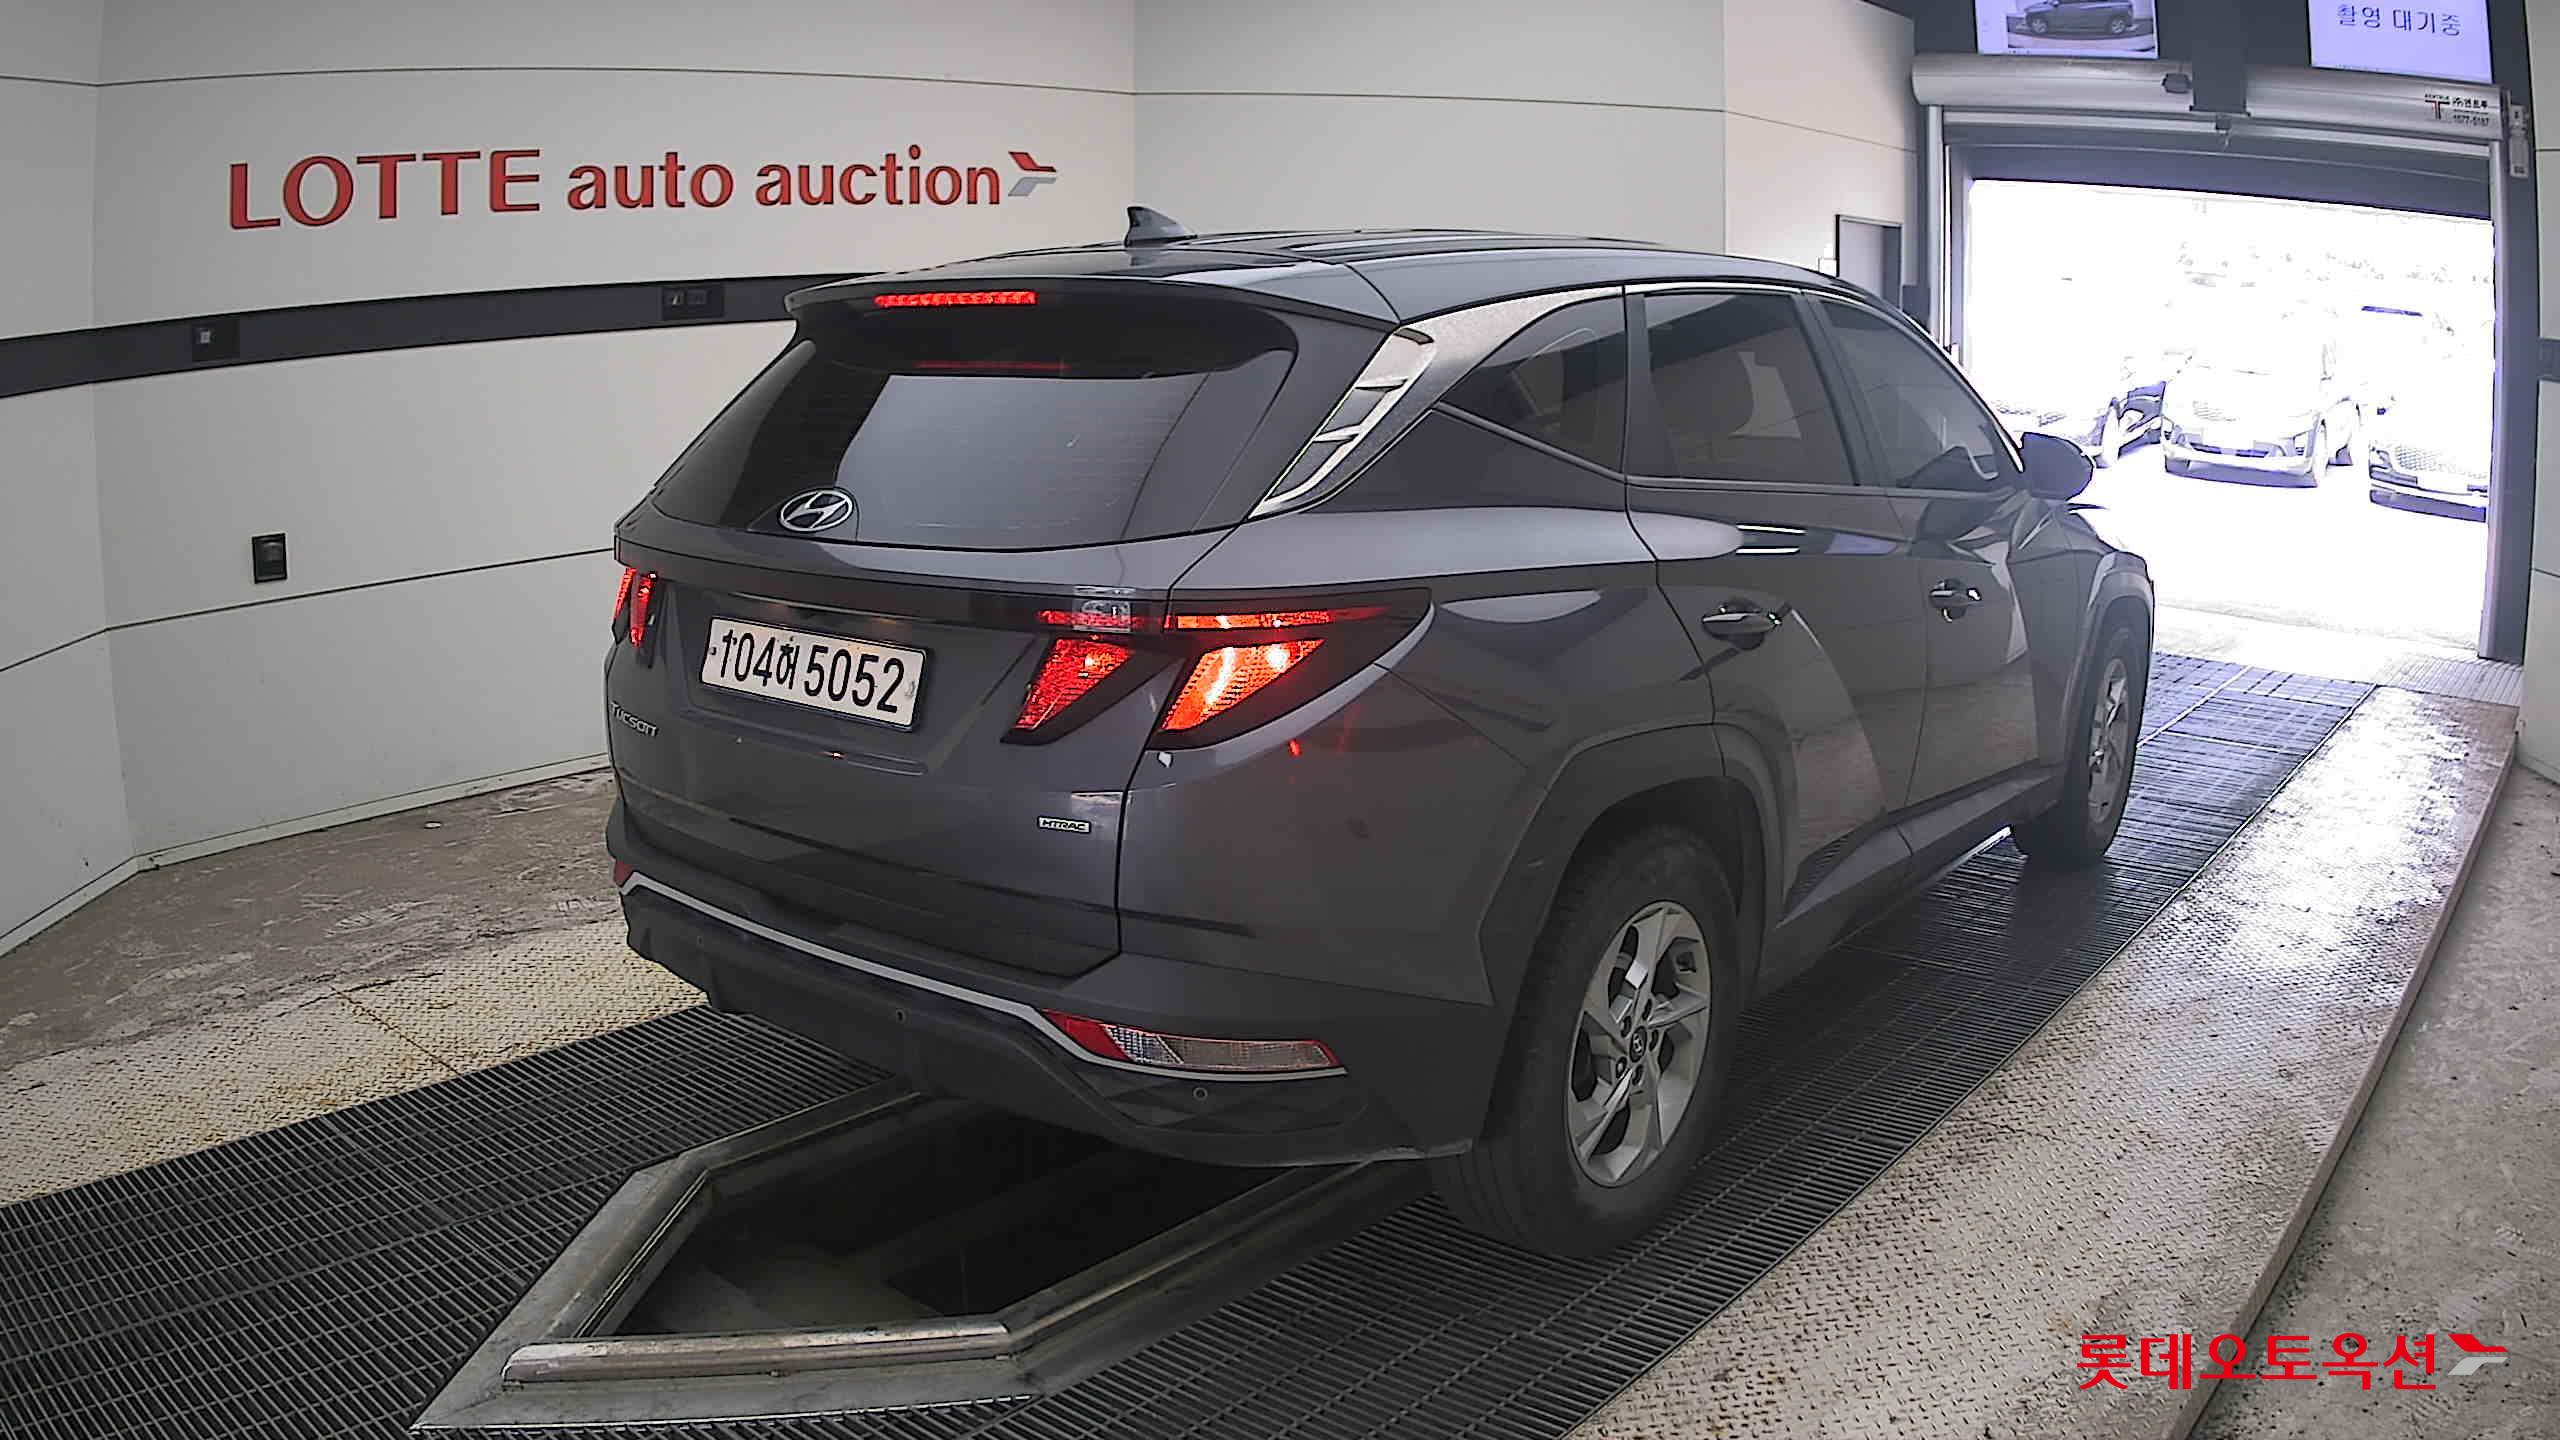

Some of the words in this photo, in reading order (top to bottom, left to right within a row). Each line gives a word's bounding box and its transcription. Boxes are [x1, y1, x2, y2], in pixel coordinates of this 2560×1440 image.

[2337, 3, 2382, 29] 촬영
[230, 150, 540, 231] LOTTE
[568, 153, 735, 209] auto
[755, 145, 1002, 207] auction
[719, 628, 905, 714] 104허5052
[610, 700, 657, 737] TUCSON
[1040, 818, 1089, 832] HTRAC
